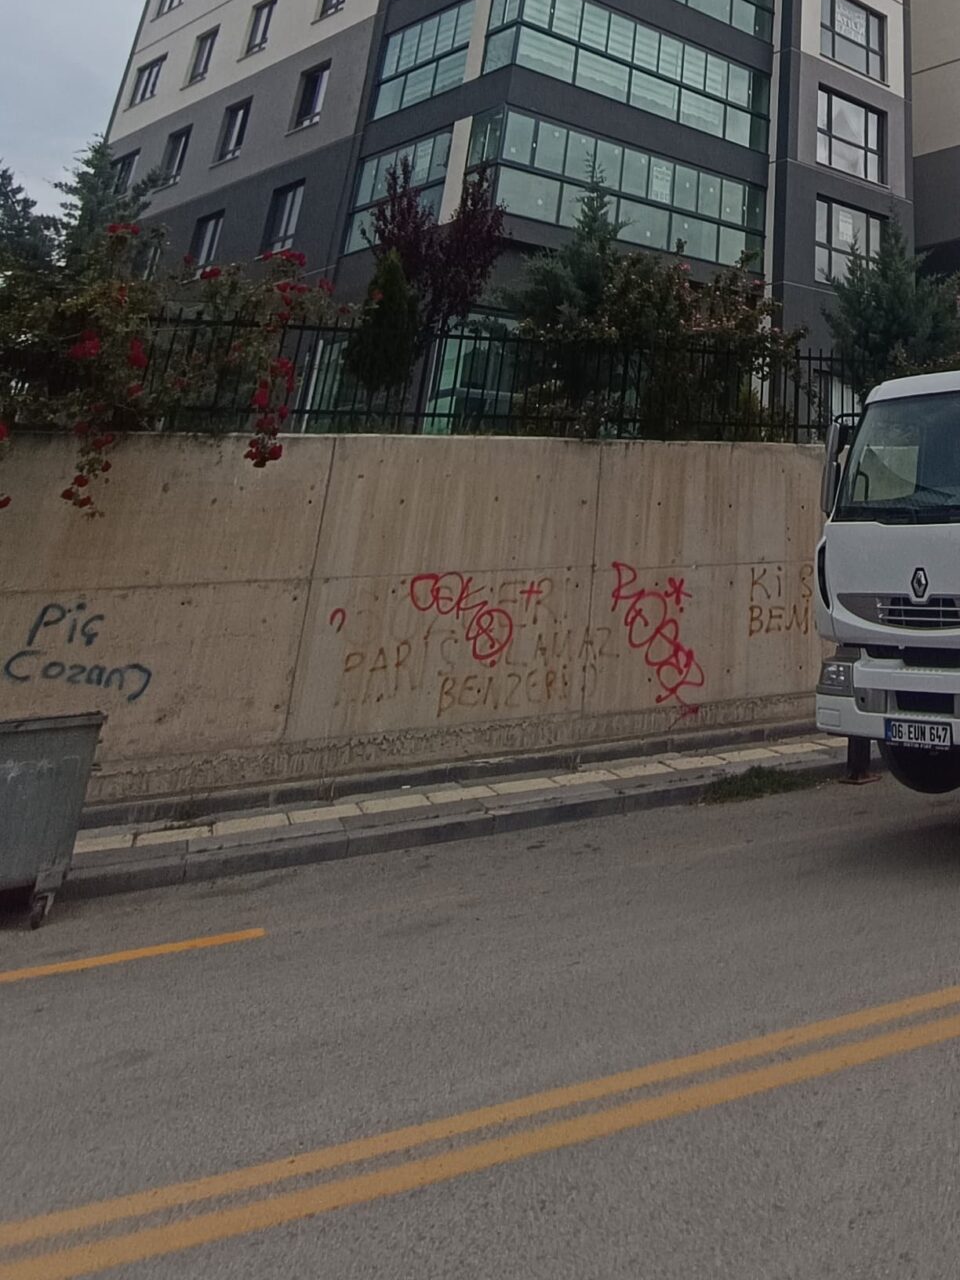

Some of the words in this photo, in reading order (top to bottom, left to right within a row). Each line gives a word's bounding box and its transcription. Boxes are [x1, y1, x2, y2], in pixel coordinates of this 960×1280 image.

[891, 723, 903, 739] 06
[907, 724, 926, 741] EUN
[929, 726, 948, 743] 647
